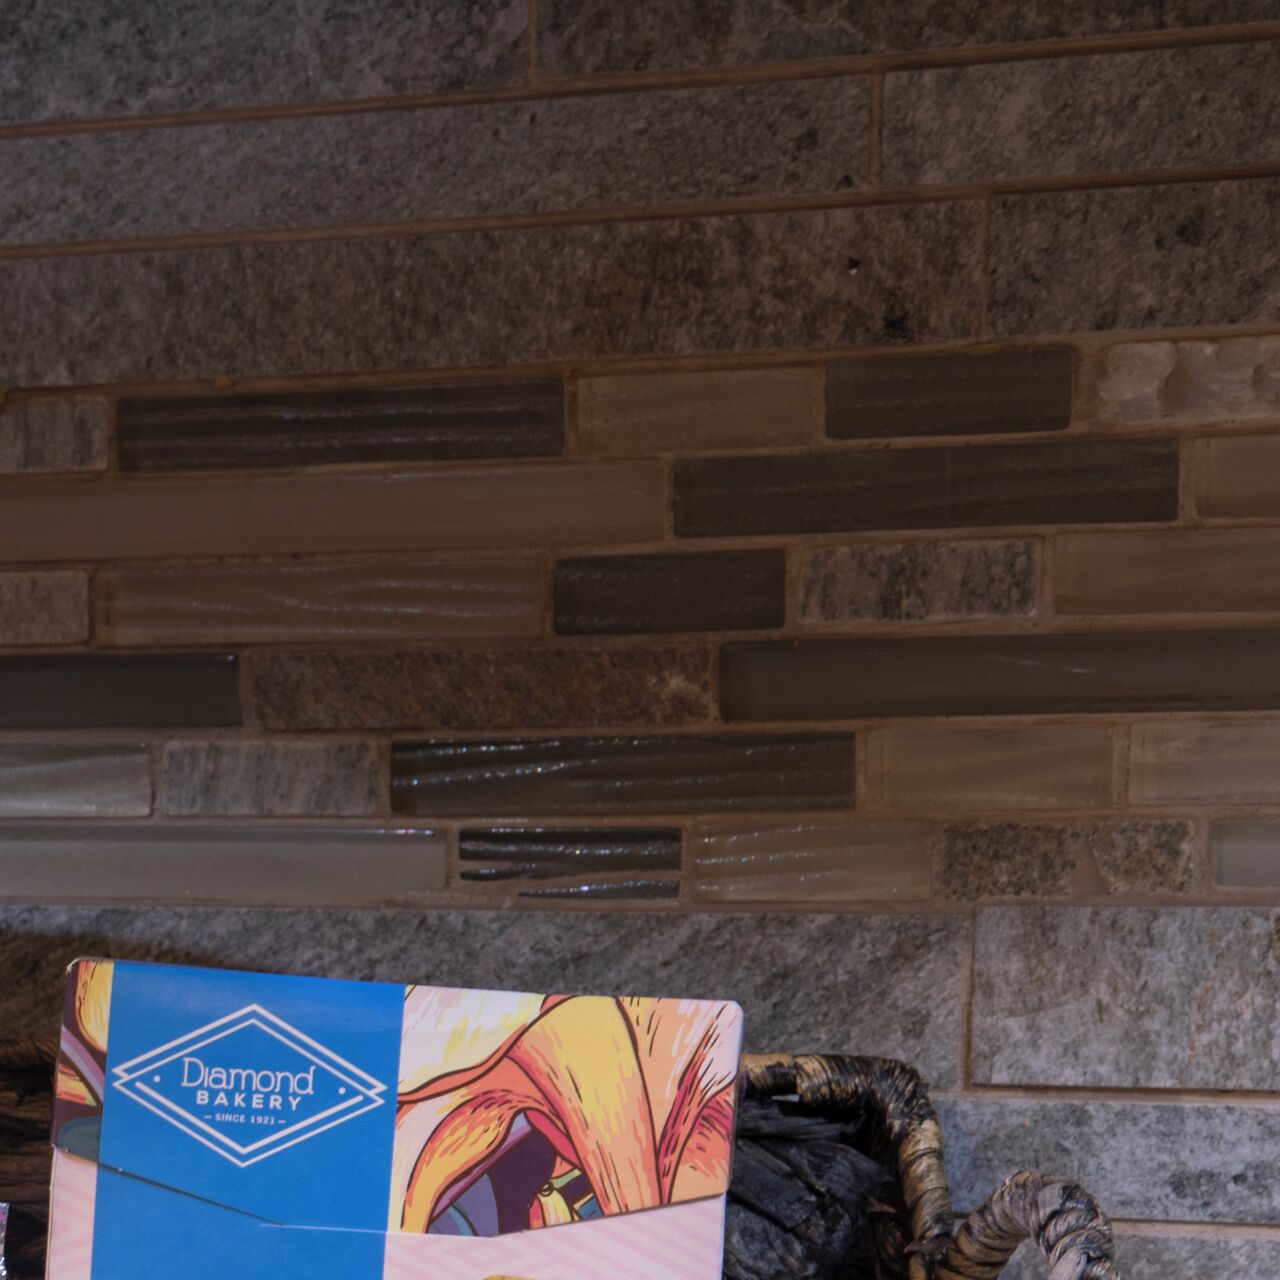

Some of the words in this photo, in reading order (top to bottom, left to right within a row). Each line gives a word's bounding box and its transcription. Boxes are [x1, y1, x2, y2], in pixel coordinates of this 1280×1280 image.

[181, 1057, 316, 1095] Diamond
[196, 1090, 302, 1111] BAKERY
[215, 1113, 246, 1123] SINCE
[250, 1115, 275, 1125] 1921
